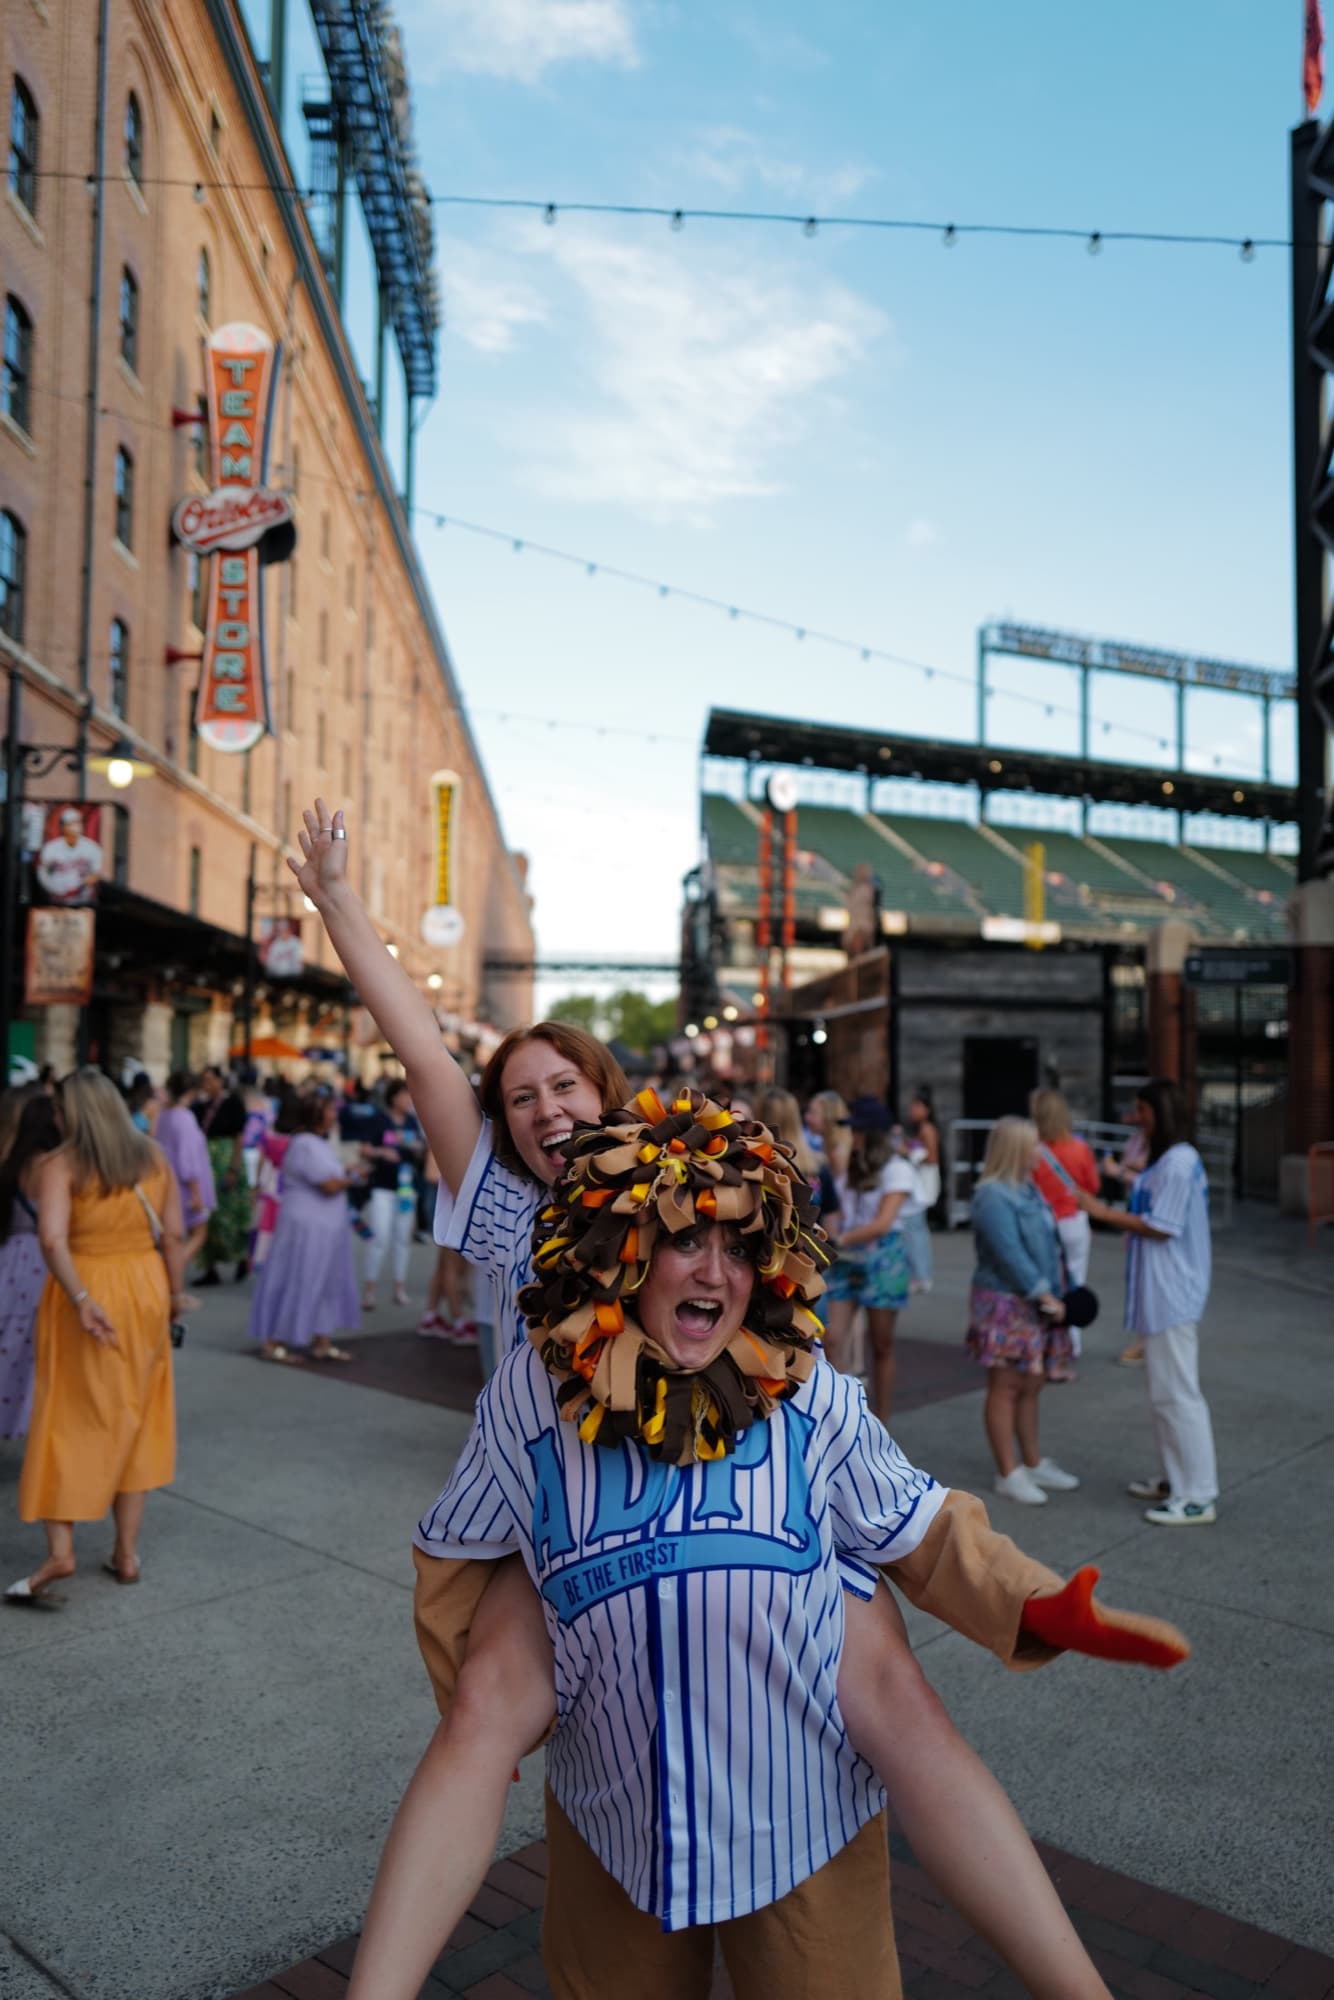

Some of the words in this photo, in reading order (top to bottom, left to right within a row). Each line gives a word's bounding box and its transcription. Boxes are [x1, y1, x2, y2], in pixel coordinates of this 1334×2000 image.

[220, 359, 257, 480] TEAM
[214, 557, 249, 712] STORE
[563, 1576, 584, 1606] BE
[582, 1562, 616, 1595] THE
